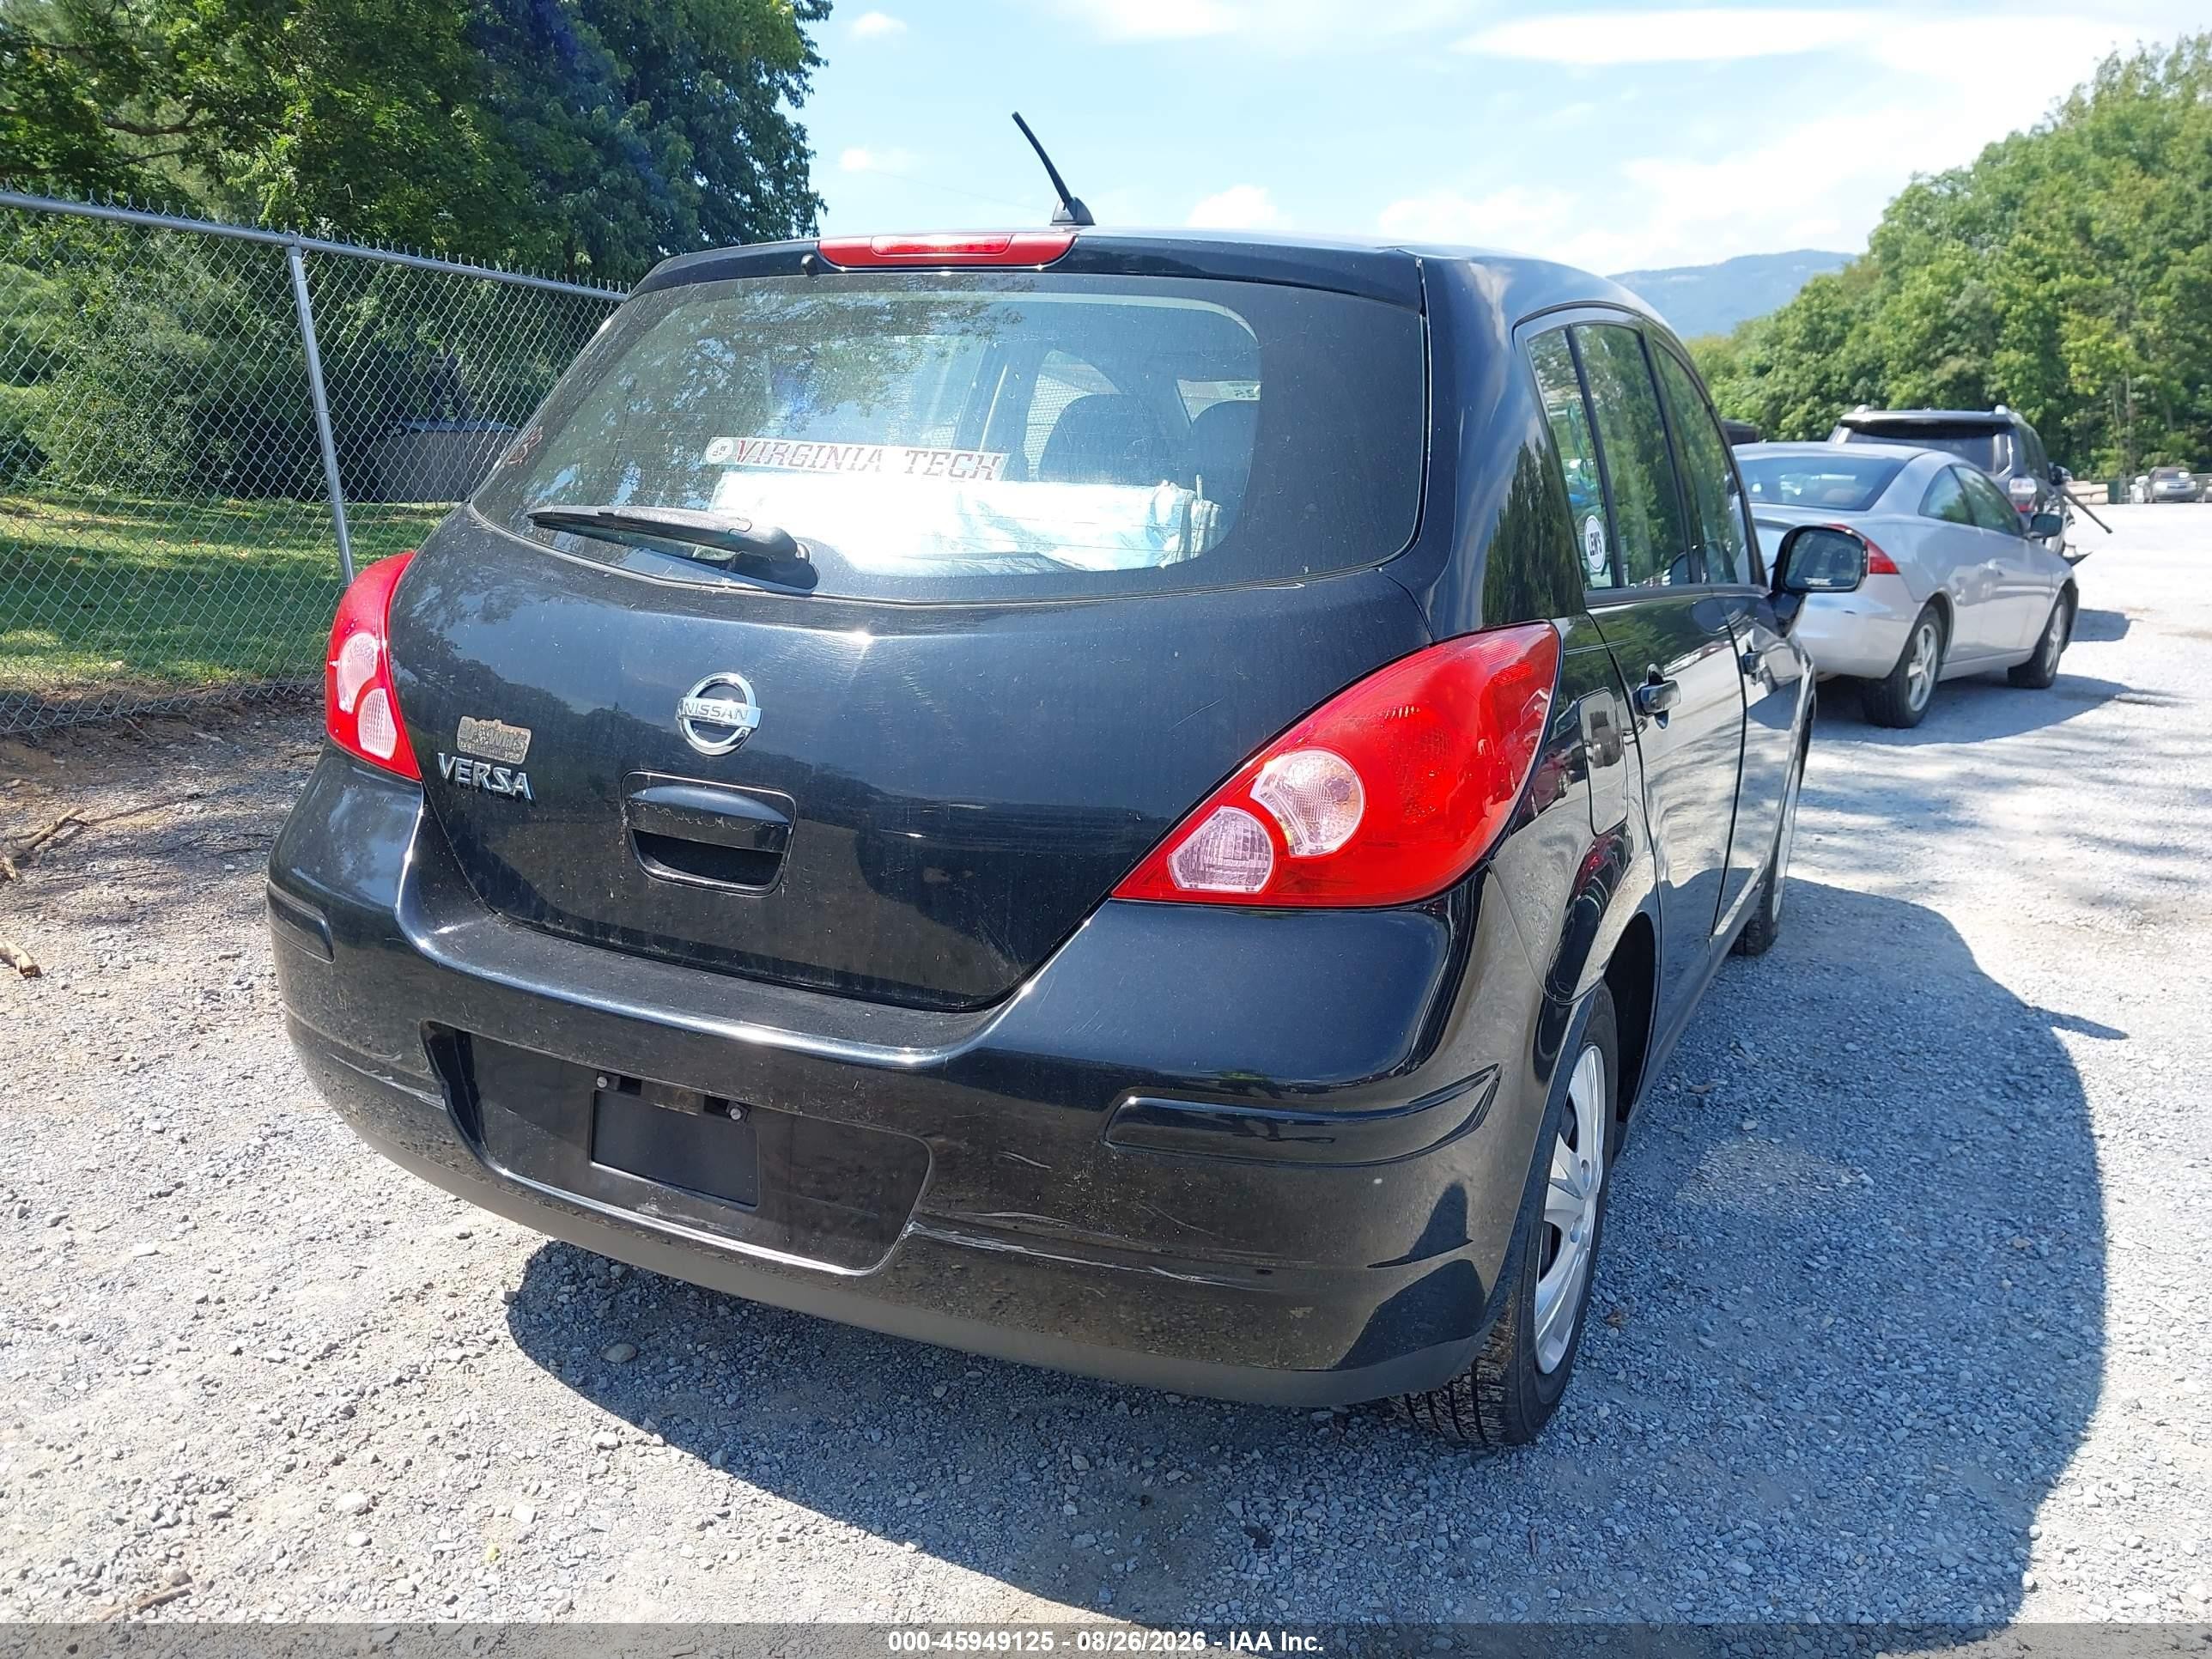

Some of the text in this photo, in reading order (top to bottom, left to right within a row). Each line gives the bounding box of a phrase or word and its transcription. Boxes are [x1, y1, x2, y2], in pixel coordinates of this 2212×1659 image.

[735, 440, 884, 471] VIRGINIA
[904, 450, 1001, 480] TECH
[684, 700, 749, 720] NISSAN
[437, 752, 533, 800] VERSA
